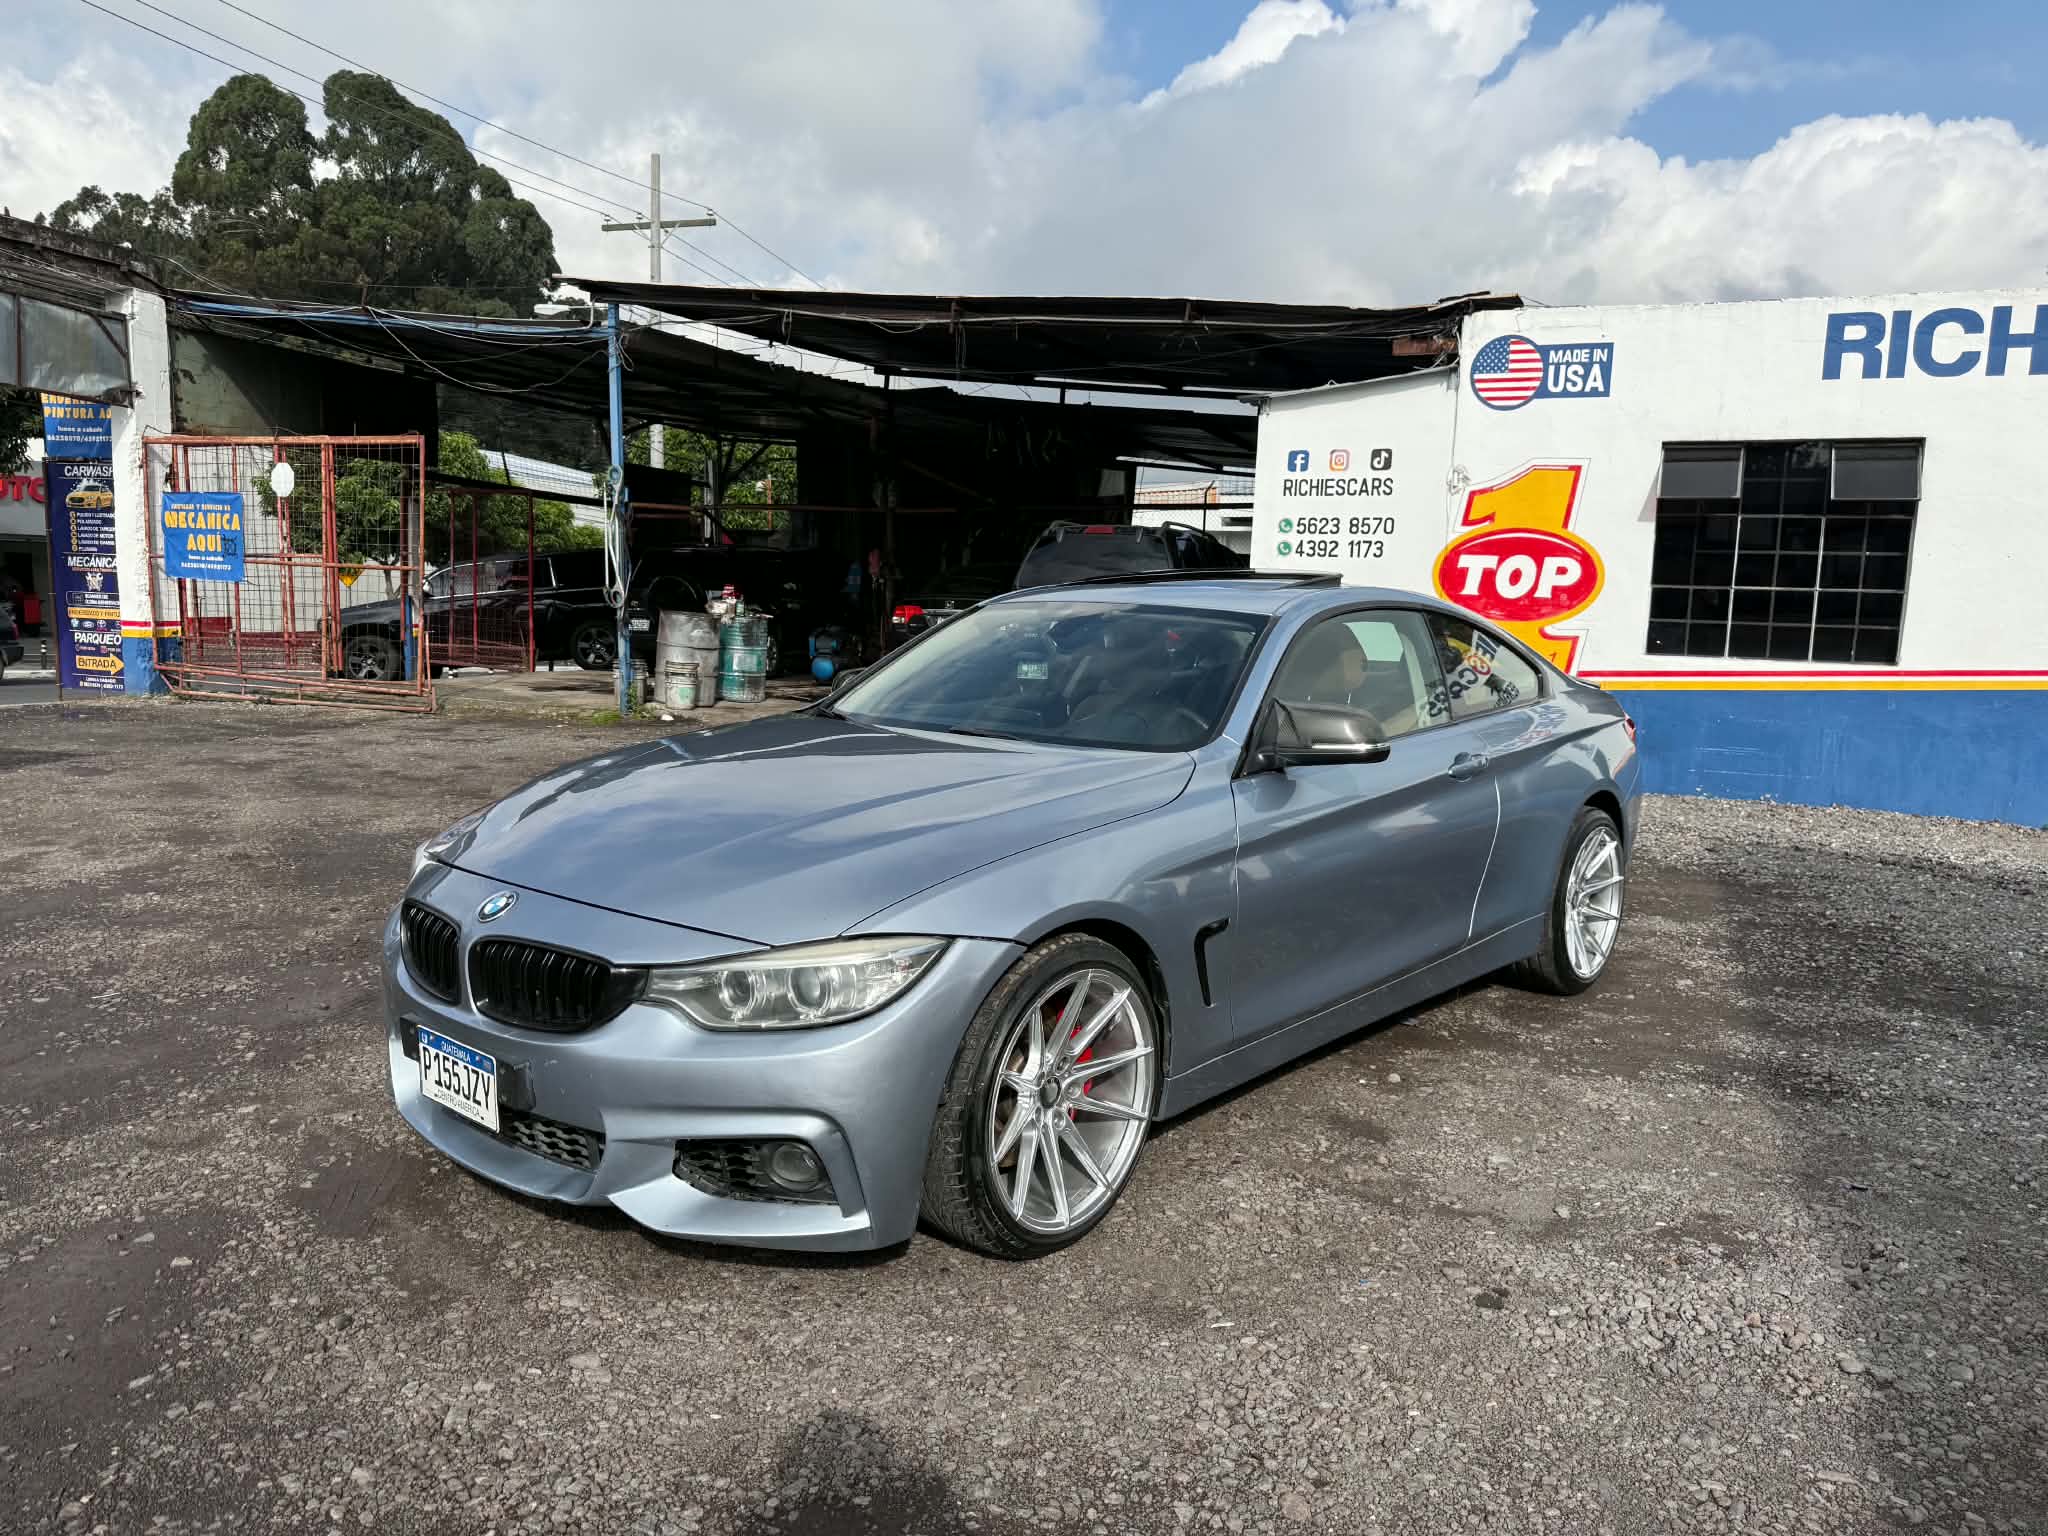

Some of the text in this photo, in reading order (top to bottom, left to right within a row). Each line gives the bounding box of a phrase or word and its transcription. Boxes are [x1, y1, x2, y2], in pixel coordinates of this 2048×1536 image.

[1822, 304, 2048, 380] RICH
[1549, 348, 1608, 364] MADE IN
[1547, 363, 1605, 393] USA
[44, 406, 94, 419] PINTURA
[1283, 477, 1394, 497] RICHIESCARS
[1296, 517, 1395, 535] 5623 8570
[1295, 539, 1384, 558] 4392 1173
[1457, 554, 1582, 600] TOP
[75, 632, 121, 645] PARQUEO
[78, 657, 117, 669] ENTRADA
[440, 1041, 472, 1064] GUATEMALA
